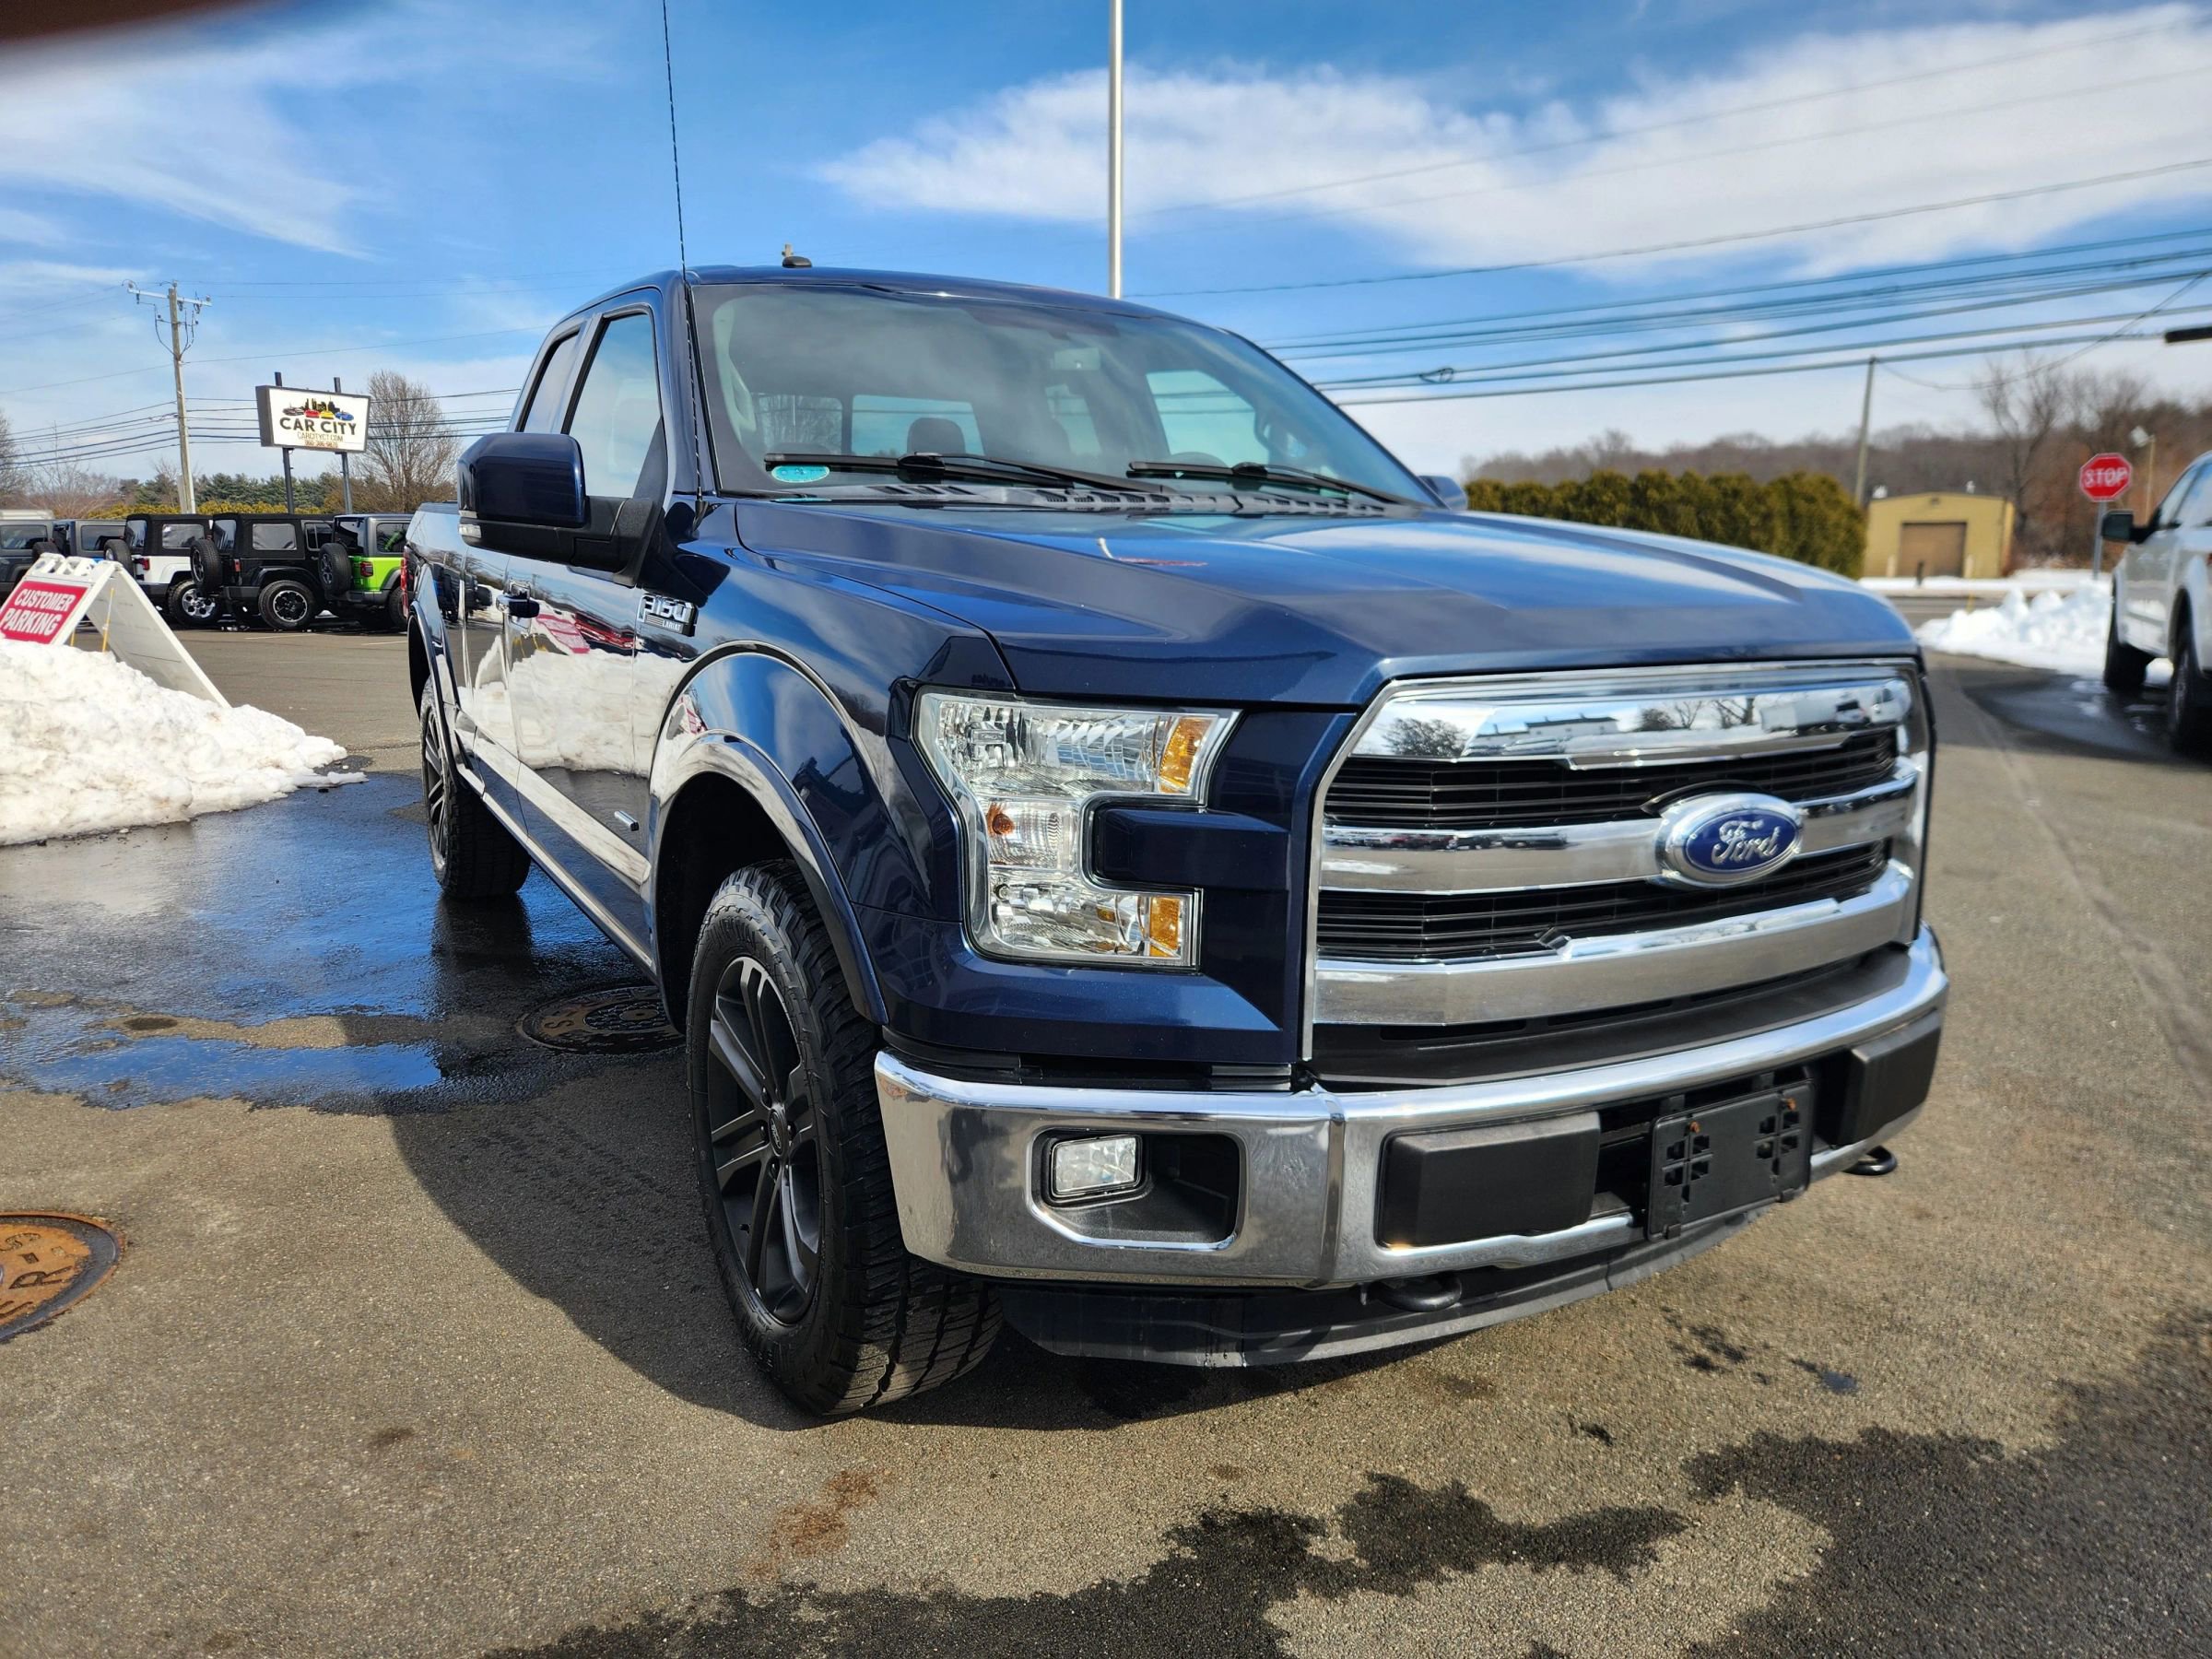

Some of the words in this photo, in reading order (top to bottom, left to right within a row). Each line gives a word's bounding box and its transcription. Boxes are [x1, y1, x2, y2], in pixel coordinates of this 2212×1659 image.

[279, 417, 315, 432] CAR
[321, 420, 357, 435] CITY
[2084, 466, 2128, 488] STOP
[14, 589, 76, 612] CUSTOMER
[3, 608, 63, 636] PARKING
[662, 620, 682, 631] LARIAT
[1711, 819, 1781, 865] Ford
